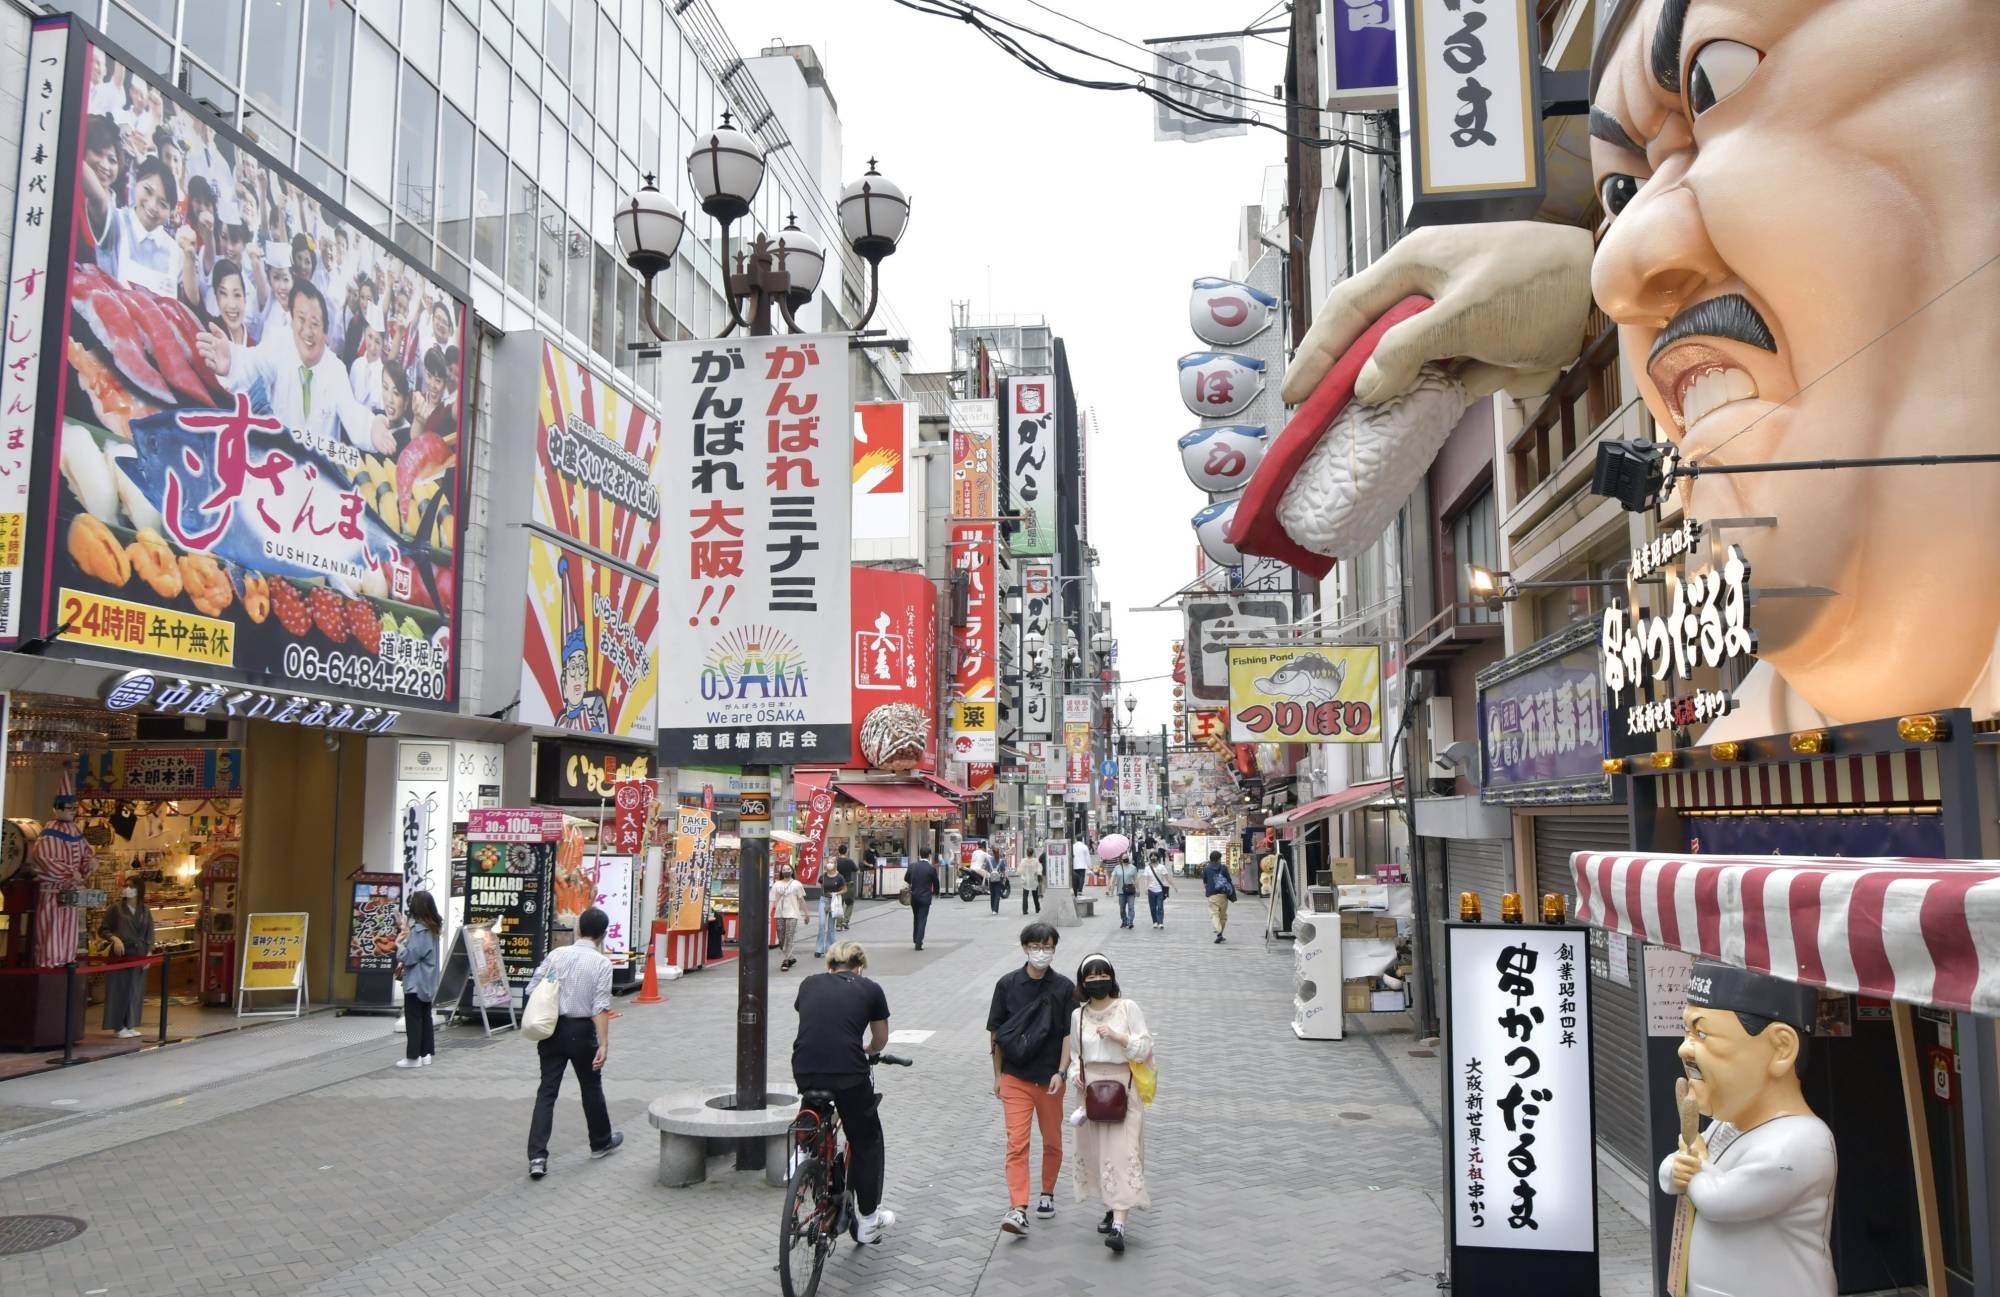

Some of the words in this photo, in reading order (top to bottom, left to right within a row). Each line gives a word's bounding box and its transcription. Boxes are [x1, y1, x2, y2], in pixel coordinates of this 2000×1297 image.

[1443, 0, 1496, 147] るま
[165, 392, 400, 573] すしざんまい
[765, 343, 819, 611] がんばれミナミ
[1015, 412, 1053, 501] がんこ
[265, 540, 363, 580] SUSHIZANMAI
[1631, 519, 1697, 580] 創業昭和四年
[64, 597, 147, 645] 24時間
[148, 615, 230, 658] 年中無休
[956, 530, 986, 677] ツルハドラッグ
[1602, 545, 1753, 709] 串かつだるま
[380, 633, 443, 671] 道頓堀店
[594, 593, 650, 681] いらっしゃいませ
[1232, 655, 1267, 666] Fishing
[1270, 653, 1294, 662] Pond
[286, 645, 444, 699] 06-6484-2280
[154, 678, 400, 733] 中座くいだおれビル
[707, 712, 728, 724] We
[732, 713, 753, 723] are
[757, 709, 805, 722] OSAKA
[964, 706, 984, 728] 薬
[1237, 701, 1372, 735] つりぼり
[1518, 672, 1599, 761] 元禄寿司
[692, 731, 818, 750] 道頓堀商店会
[128, 768, 195, 786] 太郎本舗
[681, 816, 708, 826] TAKE
[682, 826, 702, 834] OUT
[801, 815, 825, 880] 大阪みやげ
[471, 877, 523, 890] BILLIARD
[480, 892, 519, 906] DARTS
[252, 936, 300, 946] 阪神タイガース
[1553, 943, 1577, 1048] 創業昭和四年
[1496, 942, 1552, 1230] 串かつだるま
[1464, 1057, 1486, 1228] 大阪新世界元祖串かつ
